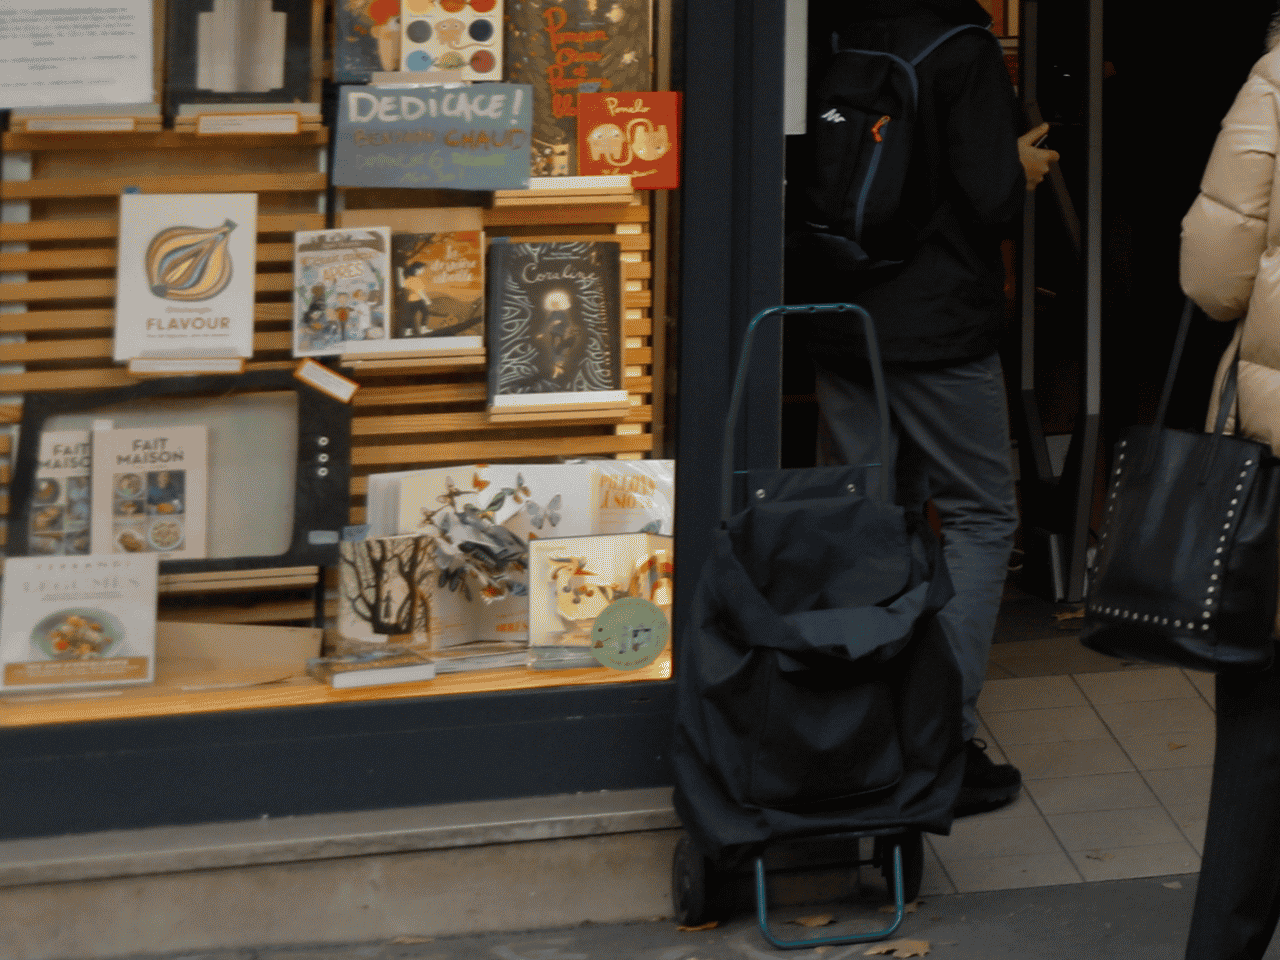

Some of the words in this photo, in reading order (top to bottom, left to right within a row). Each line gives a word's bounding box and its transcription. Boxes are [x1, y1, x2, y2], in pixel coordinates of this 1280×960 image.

[521, 262, 599, 284] Coraline
[146, 316, 231, 331] FLAVOUR
[132, 437, 168, 451] FAIT
[116, 450, 184, 466] MAISON
